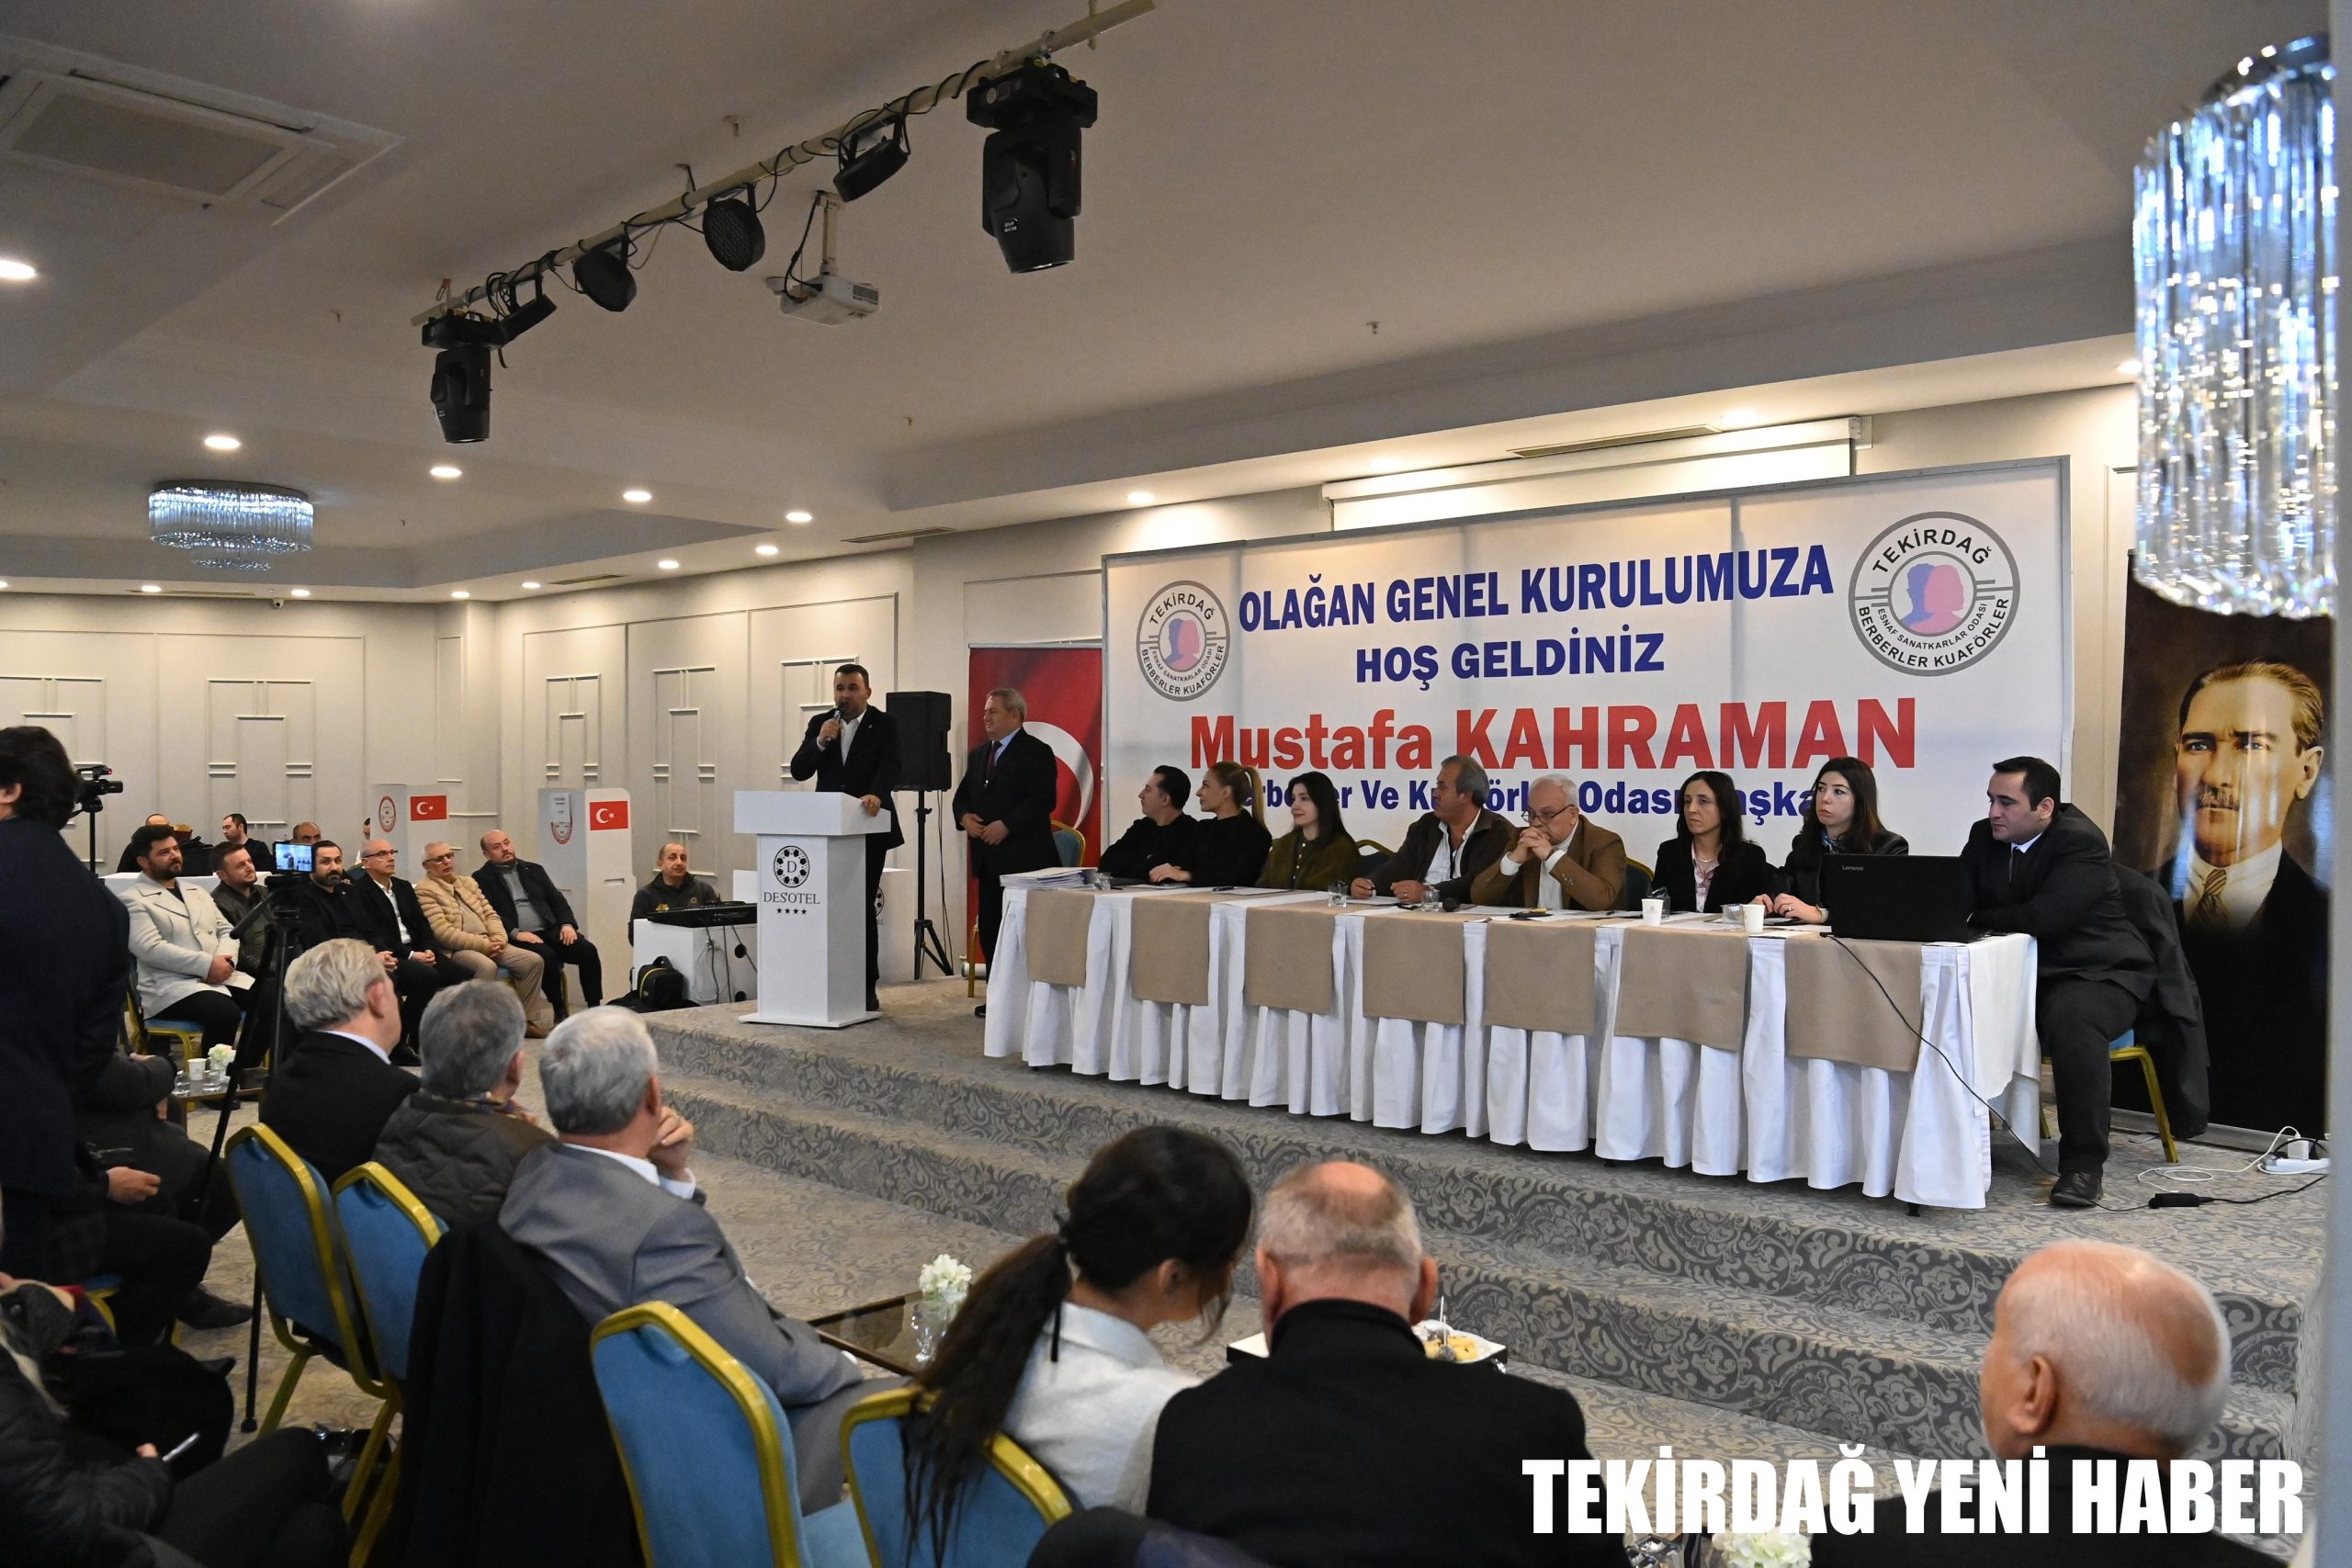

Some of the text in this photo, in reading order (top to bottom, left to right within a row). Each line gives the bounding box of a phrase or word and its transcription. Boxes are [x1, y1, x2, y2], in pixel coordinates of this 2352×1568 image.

[1872, 528, 1992, 574] TEKİRDAĞ
[1149, 592, 1215, 625] TEKİRDAĞ
[1238, 545, 1834, 632] OLAĞAN GENEL KURULUMUZA
[1859, 598, 2009, 667] BERBERLER KUAFÖRLER
[1878, 603, 1987, 649] ESNAF SANATKARLAR ODASI
[1141, 645, 1224, 695] BERBERLER KUAFÖRLER
[1356, 625, 1665, 691] HOŞ GELDİNİZ
[1191, 698, 1916, 770] Mustafa KAHRAMAN
[1362, 779, 1399, 810] Ve
